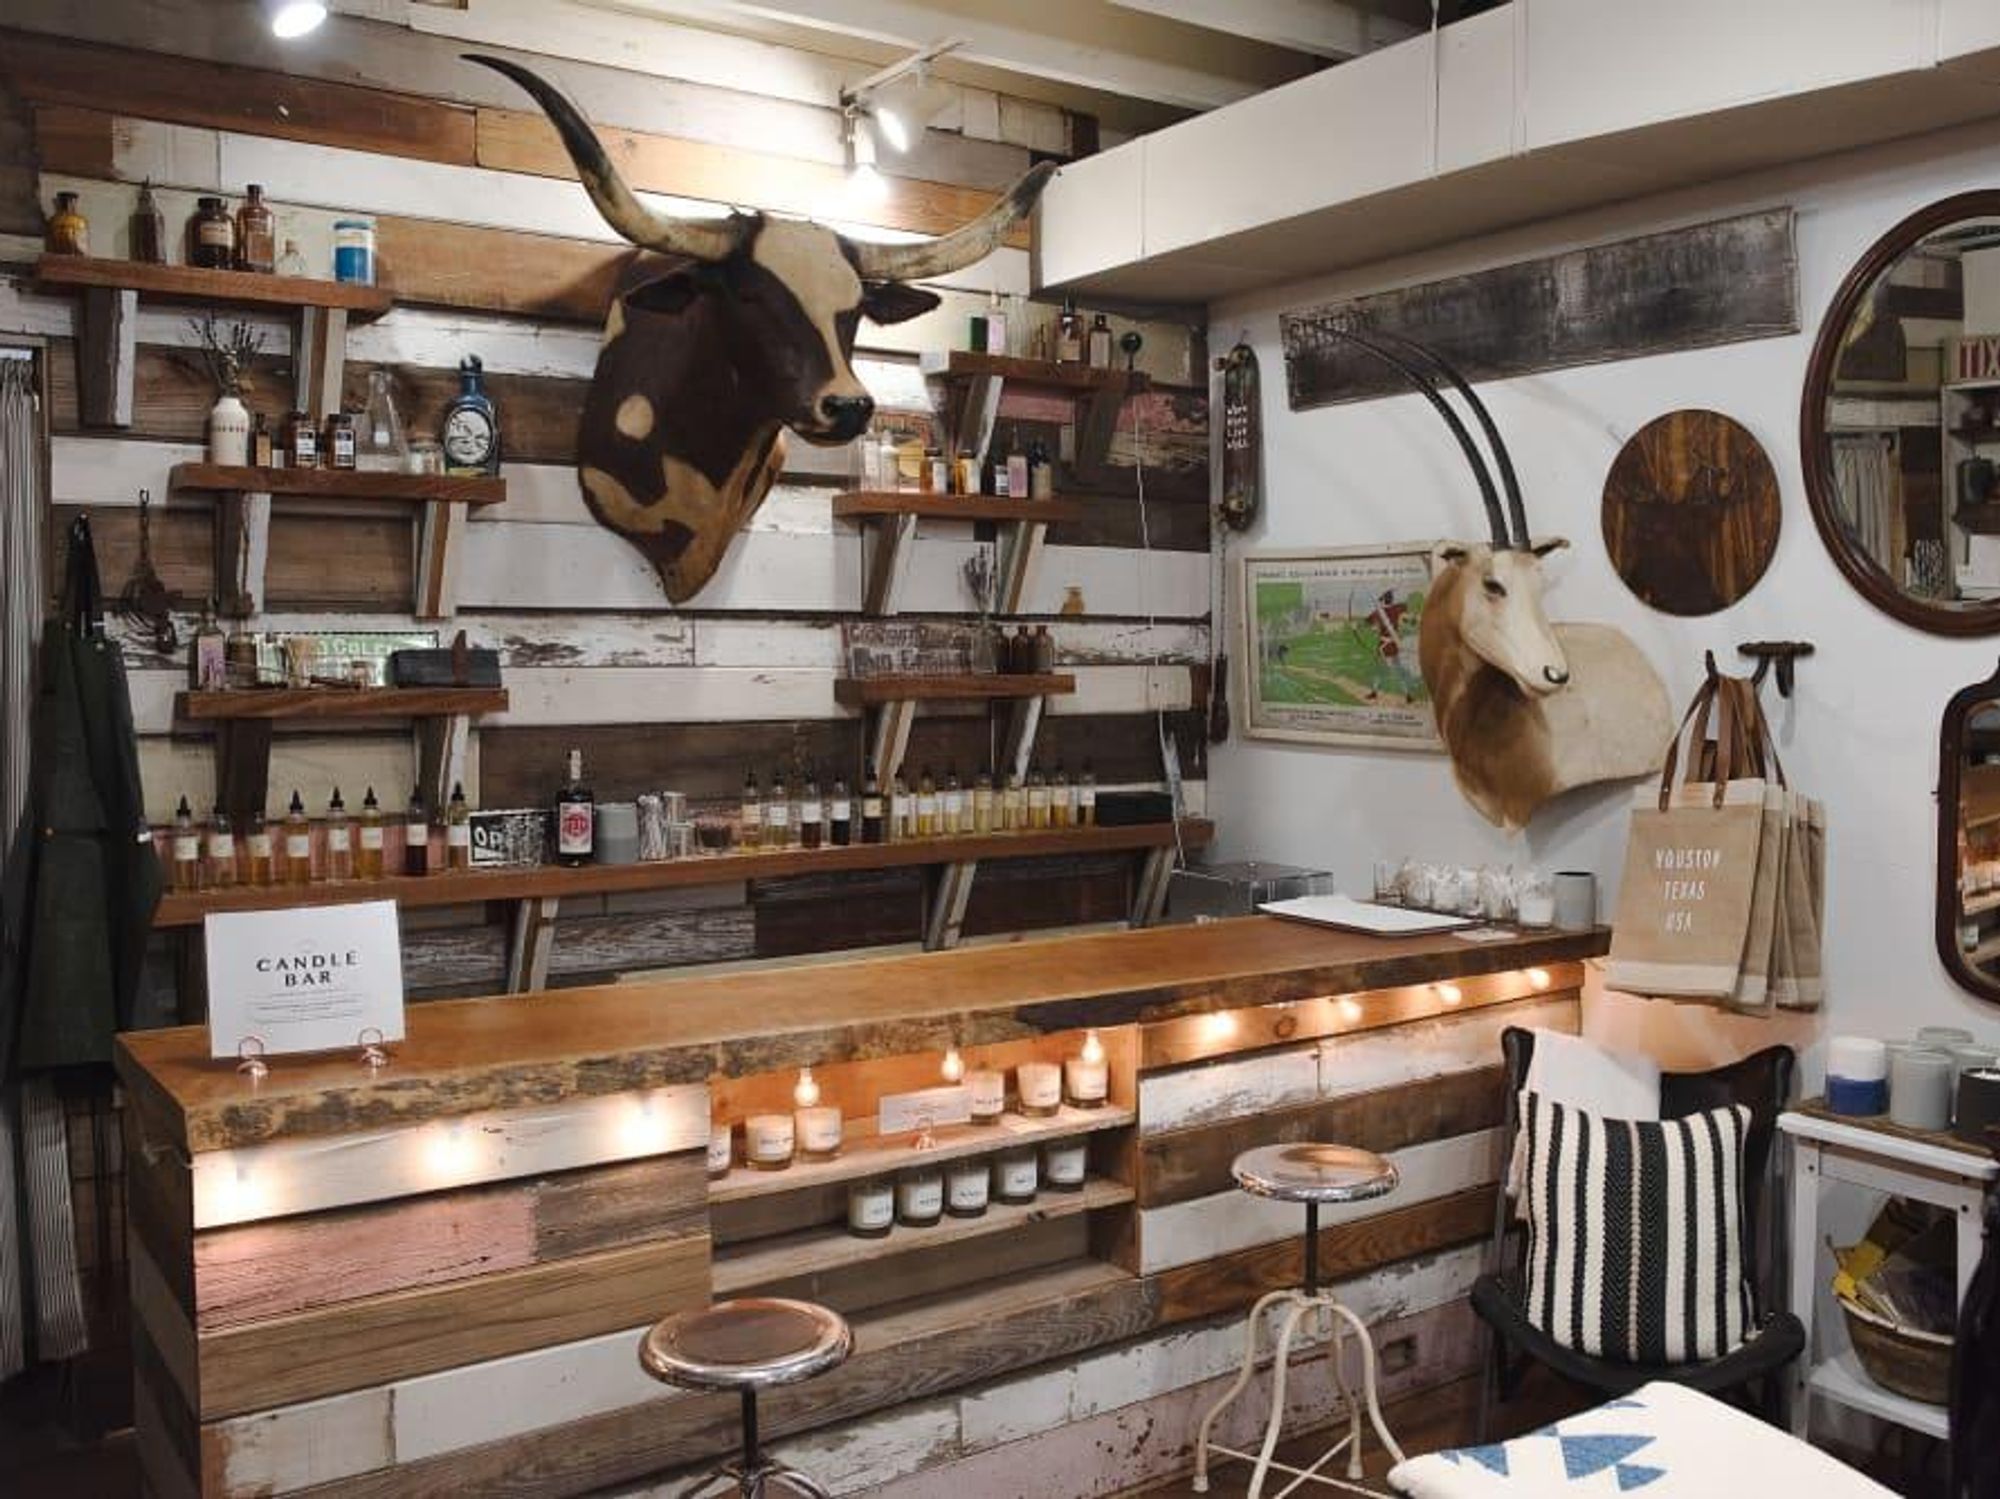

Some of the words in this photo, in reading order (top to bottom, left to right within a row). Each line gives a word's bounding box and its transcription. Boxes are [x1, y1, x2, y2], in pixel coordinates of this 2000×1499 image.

[1664, 880, 1706, 901] TEXAS
[256, 951, 359, 972] CANDLE
[285, 970, 331, 987] BAR
